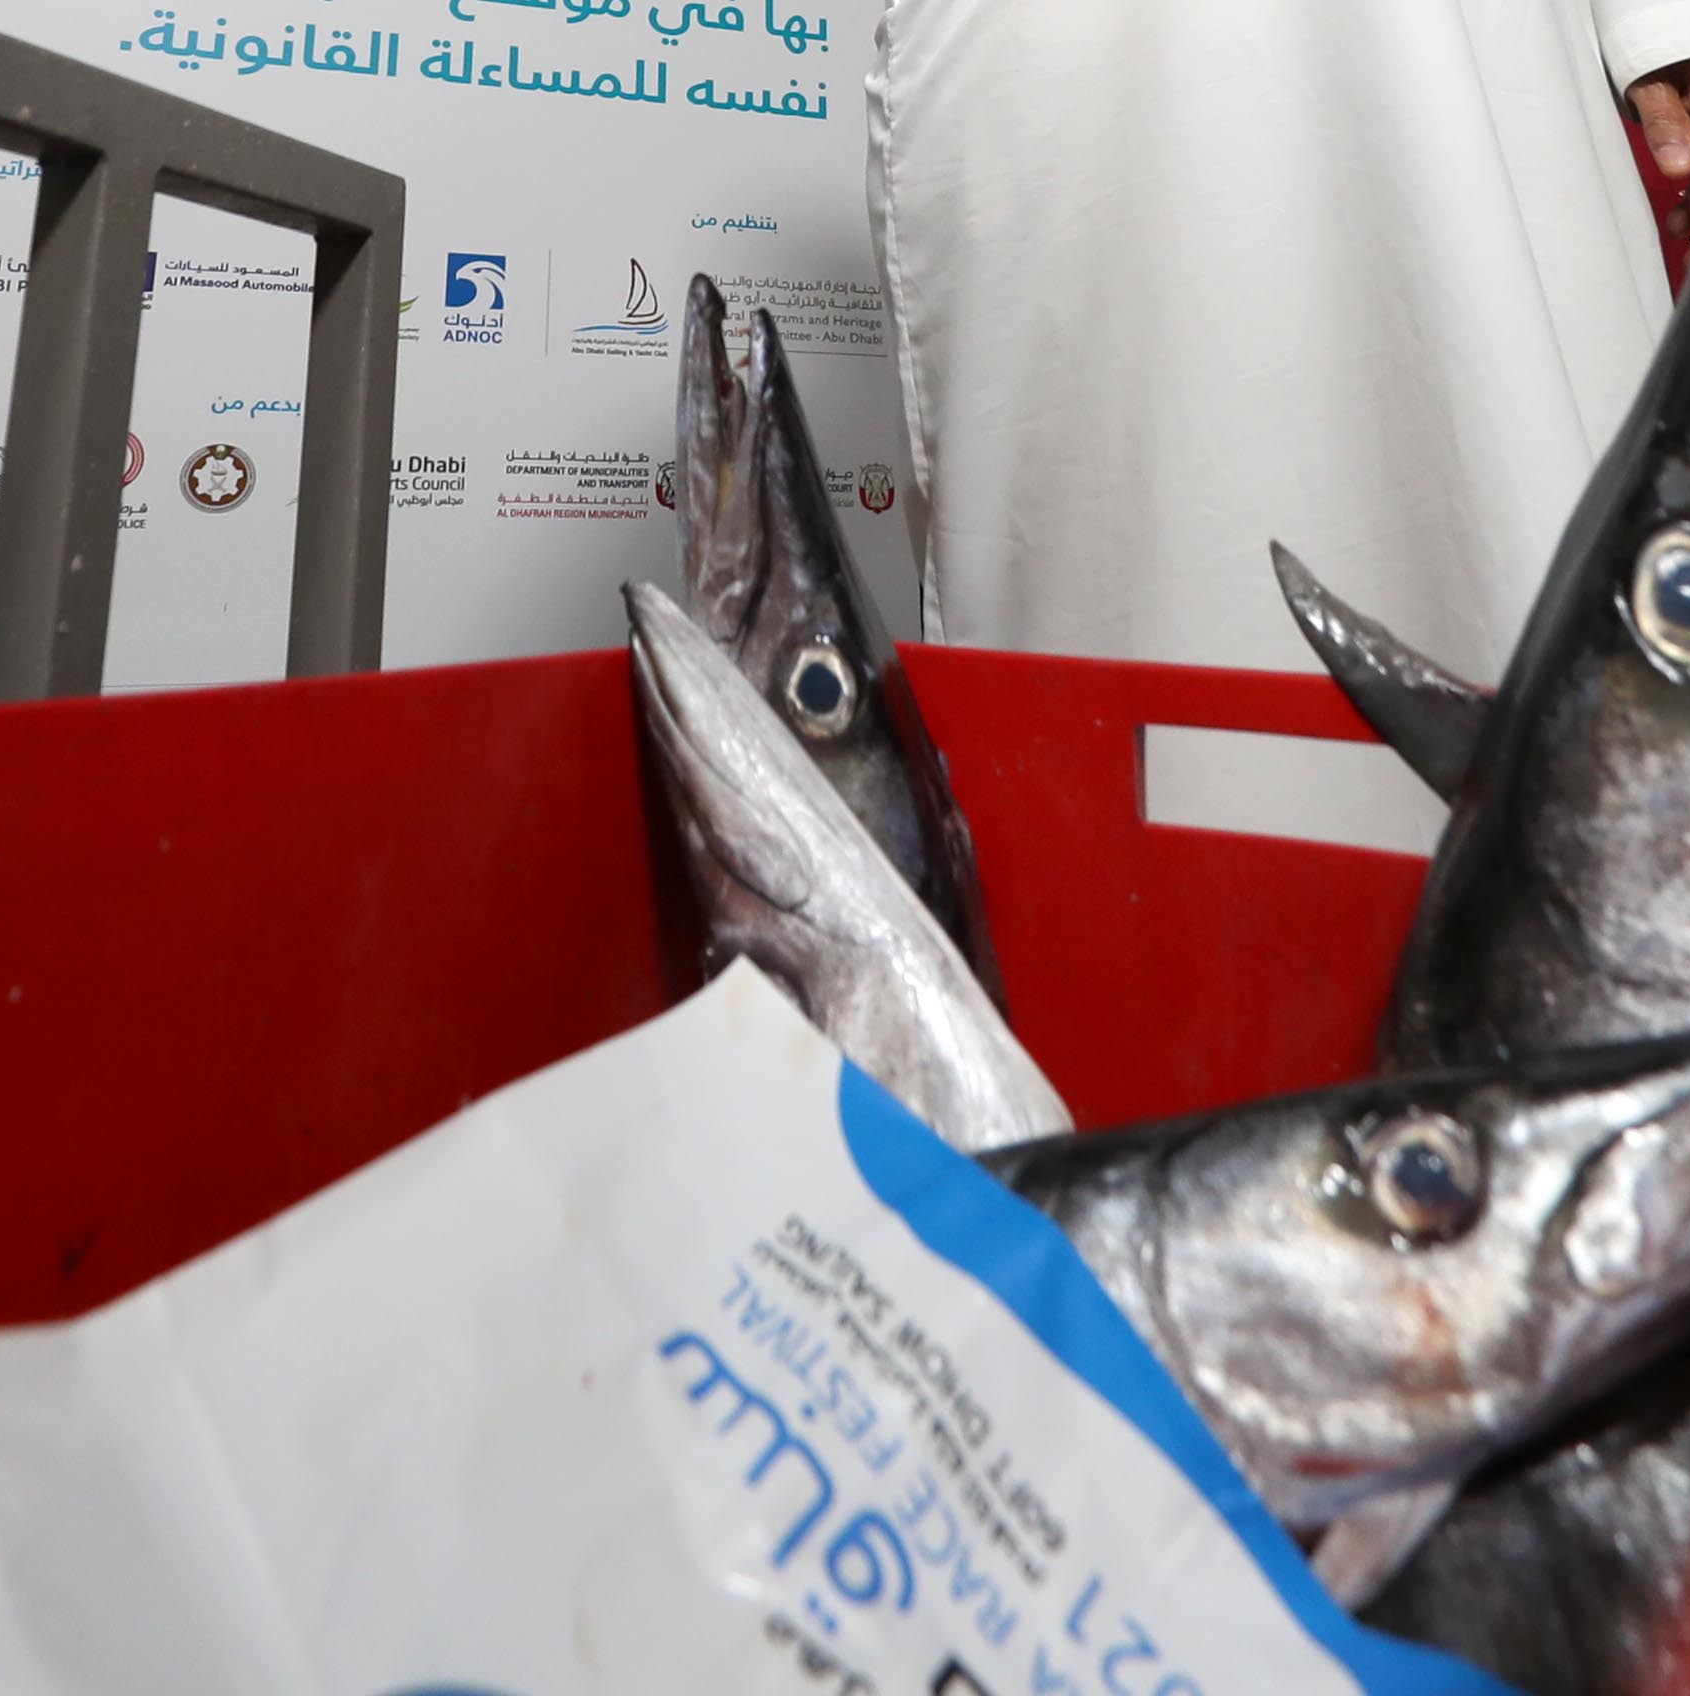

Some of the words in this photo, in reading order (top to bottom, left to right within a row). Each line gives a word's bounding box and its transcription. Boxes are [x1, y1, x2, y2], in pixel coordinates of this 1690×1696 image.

[119, 8, 401, 77] القانونية.
[419, 38, 669, 105] للمساءلة
[685, 77, 829, 121] نفسه
[691, 213, 718, 229] من
[721, 214, 779, 234] بتنظيم
[163, 276, 178, 287] Al
[179, 275, 239, 290] Masaood
[443, 313, 504, 329] أدنوك
[808, 314, 830, 325] and
[832, 316, 883, 331] Heritage
[443, 329, 503, 344] ADNOC
[822, 333, 847, 344] Abu
[849, 332, 884, 345] Dhabi
[210, 395, 245, 415] من
[249, 398, 302, 419] بدعم
[408, 455, 466, 474] Dhabi
[505, 464, 566, 476] DEPARTMENT
[567, 466, 579, 476] OF
[580, 467, 650, 478] MUNICIPALITIES
[412, 475, 465, 492] Council
[576, 478, 597, 489] AND
[598, 479, 650, 489] TRANSPORT
[496, 508, 509, 518] AL
[509, 508, 553, 519] DHAFRAH
[553, 509, 587, 519] REGION
[587, 509, 649, 520] MUNICIPALITY
[116, 519, 147, 530] OLICE
[721, 1260, 903, 1474] FESTIVAL
[658, 1328, 916, 1635] سباق
[895, 1468, 1020, 1647] RACE
